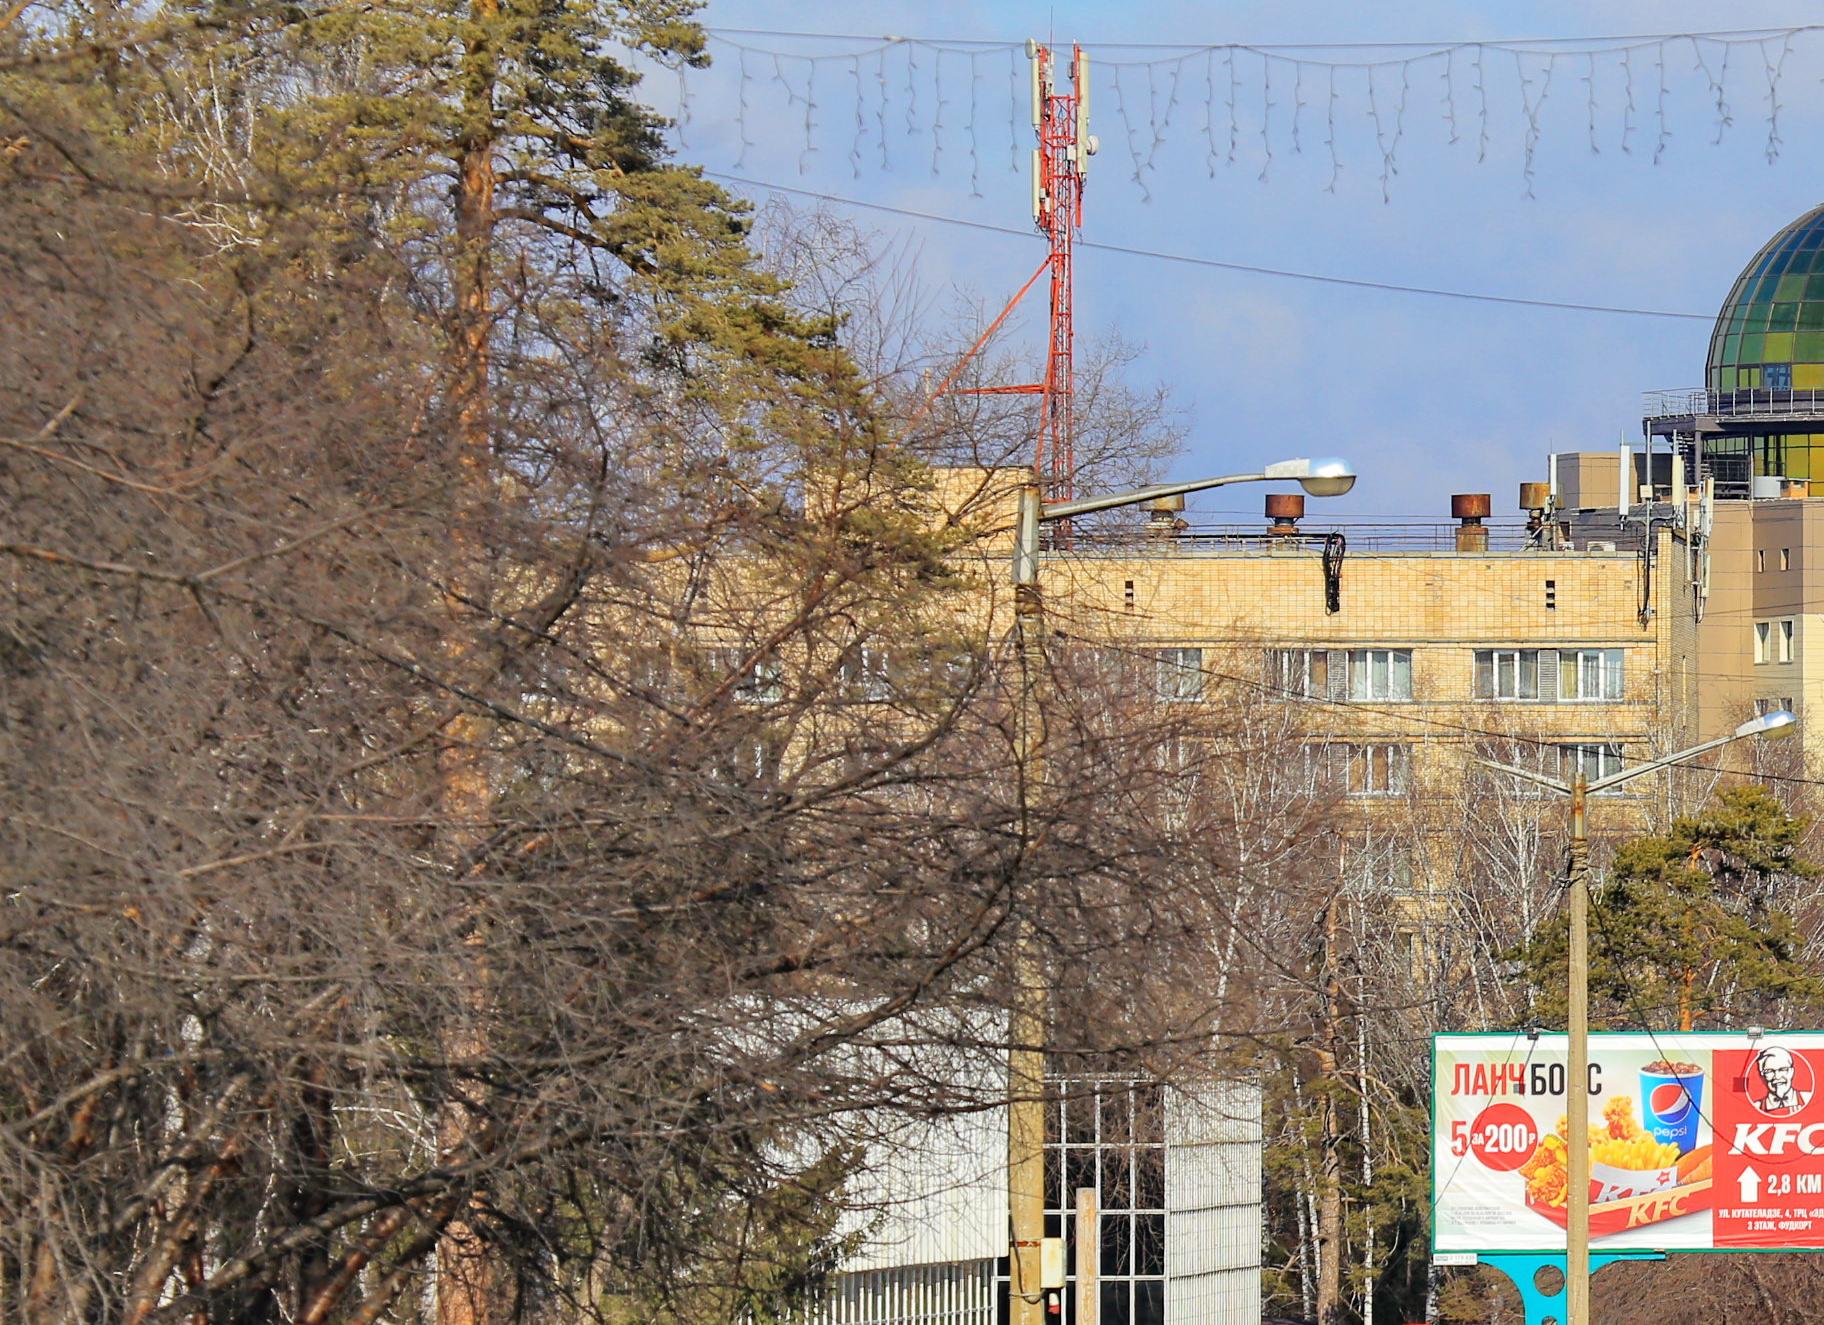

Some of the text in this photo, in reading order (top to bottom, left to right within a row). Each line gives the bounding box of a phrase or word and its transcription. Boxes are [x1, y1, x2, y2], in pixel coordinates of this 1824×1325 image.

[1451, 1120, 1468, 1157] 5
[1653, 1126, 1688, 1139] pepsi
[1767, 1173, 1822, 1196] 2,8 КМ
[1625, 1194, 1691, 1228] KFC
